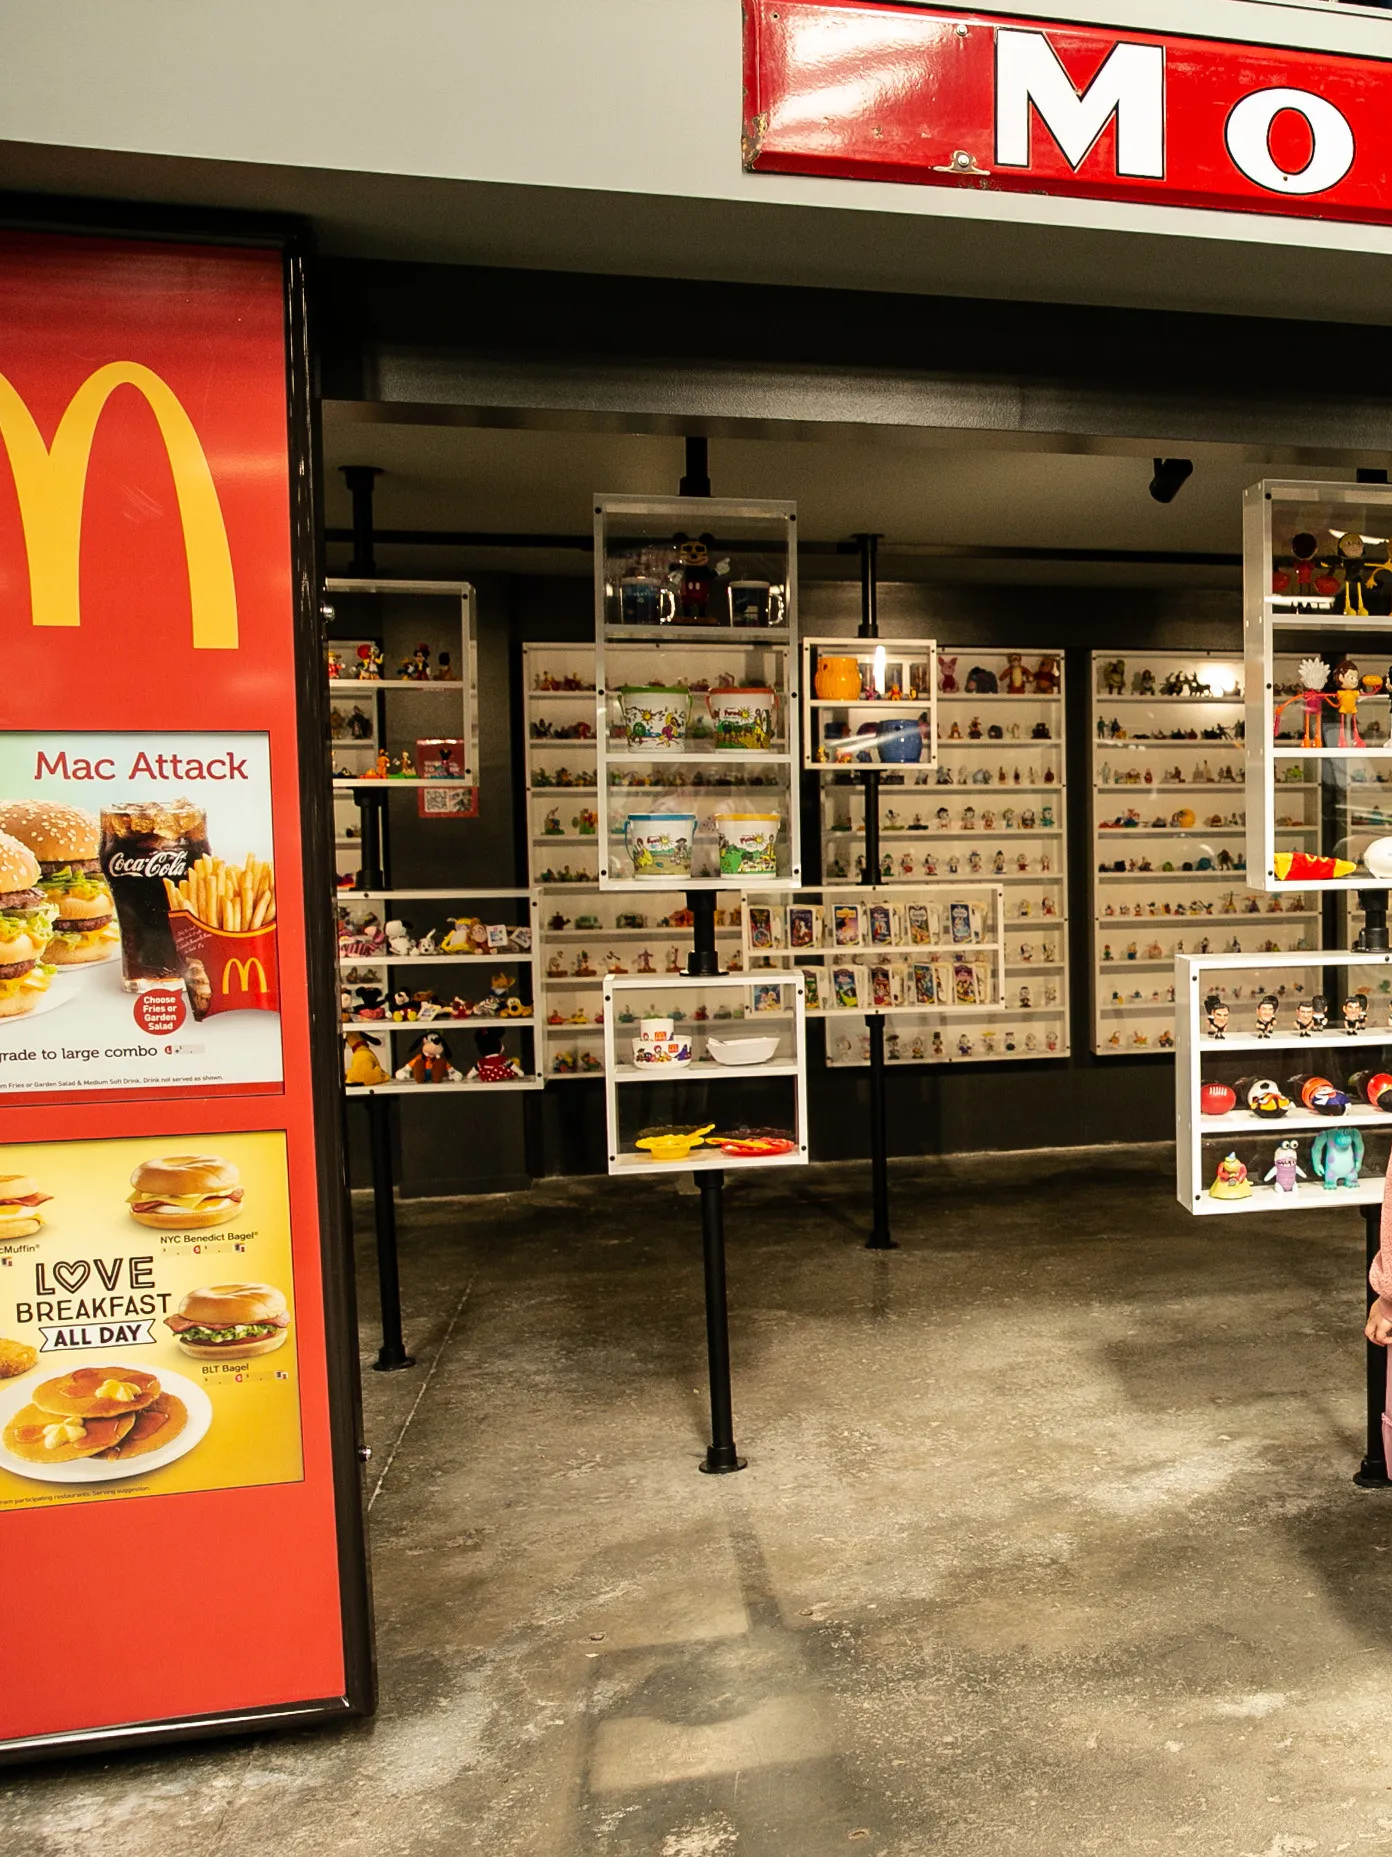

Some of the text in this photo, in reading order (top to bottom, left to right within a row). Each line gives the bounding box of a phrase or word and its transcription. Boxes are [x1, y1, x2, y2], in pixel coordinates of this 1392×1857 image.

[34, 751, 249, 781] Mac Attack
[144, 996, 176, 1004] Choose
[143, 1005, 166, 1013] Fries
[144, 1014, 177, 1022] Garden
[148, 1022, 174, 1031] Salad
[0, 1049, 36, 1063] rade
[41, 1049, 57, 1060] to
[61, 1048, 99, 1062] large
[104, 1045, 158, 1058] combo
[160, 1235, 181, 1244] NYC
[184, 1233, 225, 1243] Benedict
[16, 1293, 172, 1324] BREAKFAST
[54, 1324, 142, 1347] ALL DAY
[202, 1363, 249, 1374] BLT Bagel
